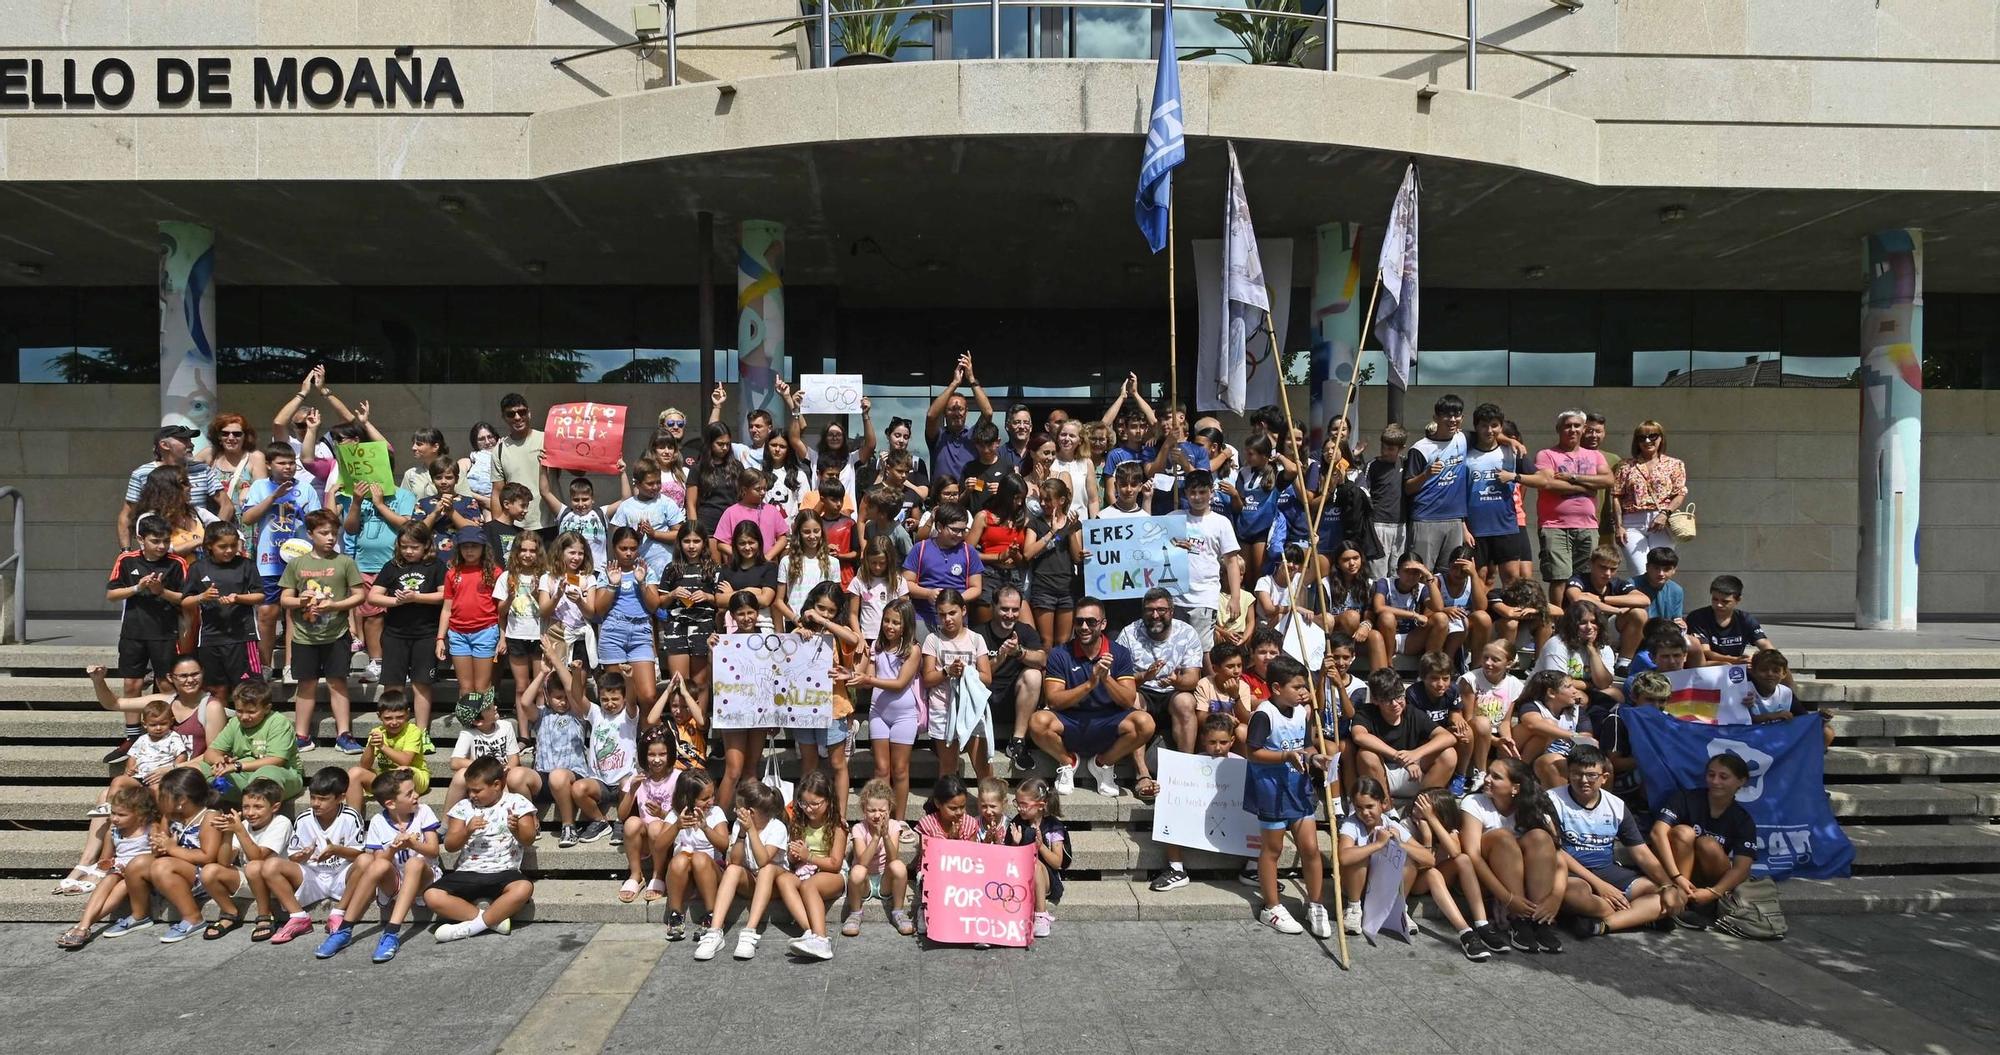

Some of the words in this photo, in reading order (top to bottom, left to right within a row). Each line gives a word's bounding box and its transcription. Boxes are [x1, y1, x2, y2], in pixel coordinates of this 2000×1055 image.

[157, 57, 232, 107] DE
[253, 46, 465, 108] MOAÑA
[1090, 524, 1134, 545] ERES
[1097, 550, 1121, 566] UN
[1096, 567, 1155, 595] CRACK
[940, 854, 985, 874] IMOS
[944, 880, 983, 908] POR
